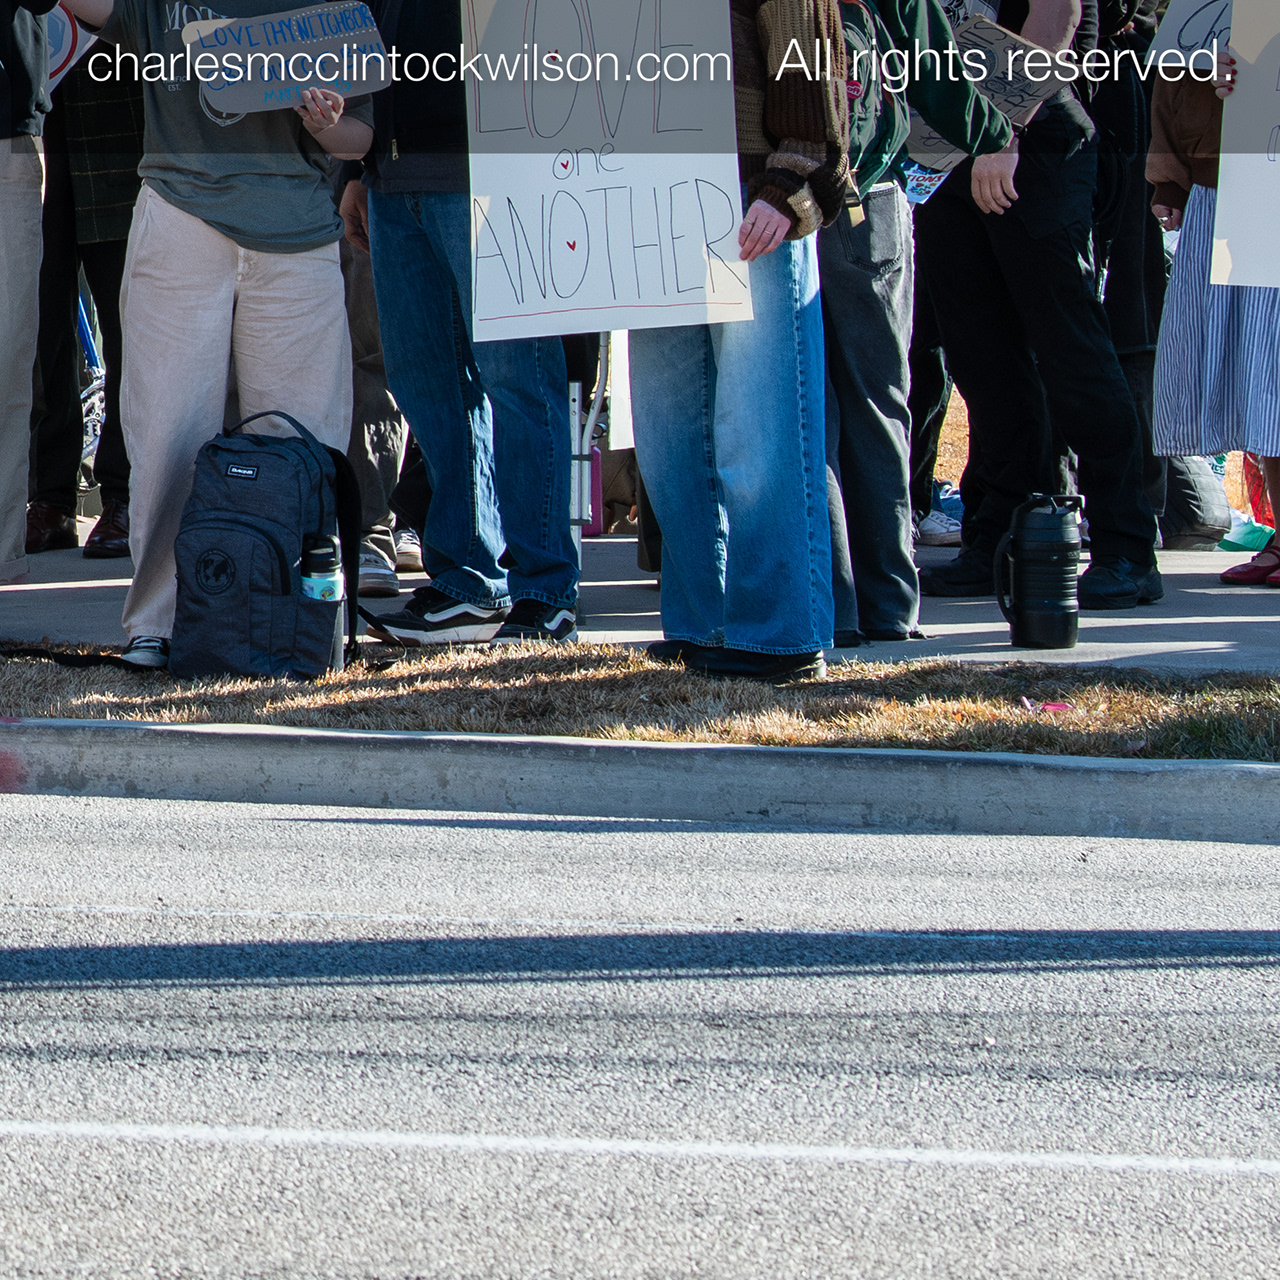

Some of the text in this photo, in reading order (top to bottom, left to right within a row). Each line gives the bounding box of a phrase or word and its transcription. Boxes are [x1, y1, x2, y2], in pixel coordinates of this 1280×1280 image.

[197, 4, 376, 49] LOVE THY NEIGHBOR
[552, 142, 624, 180] one
[473, 178, 748, 314] ANOTHER
